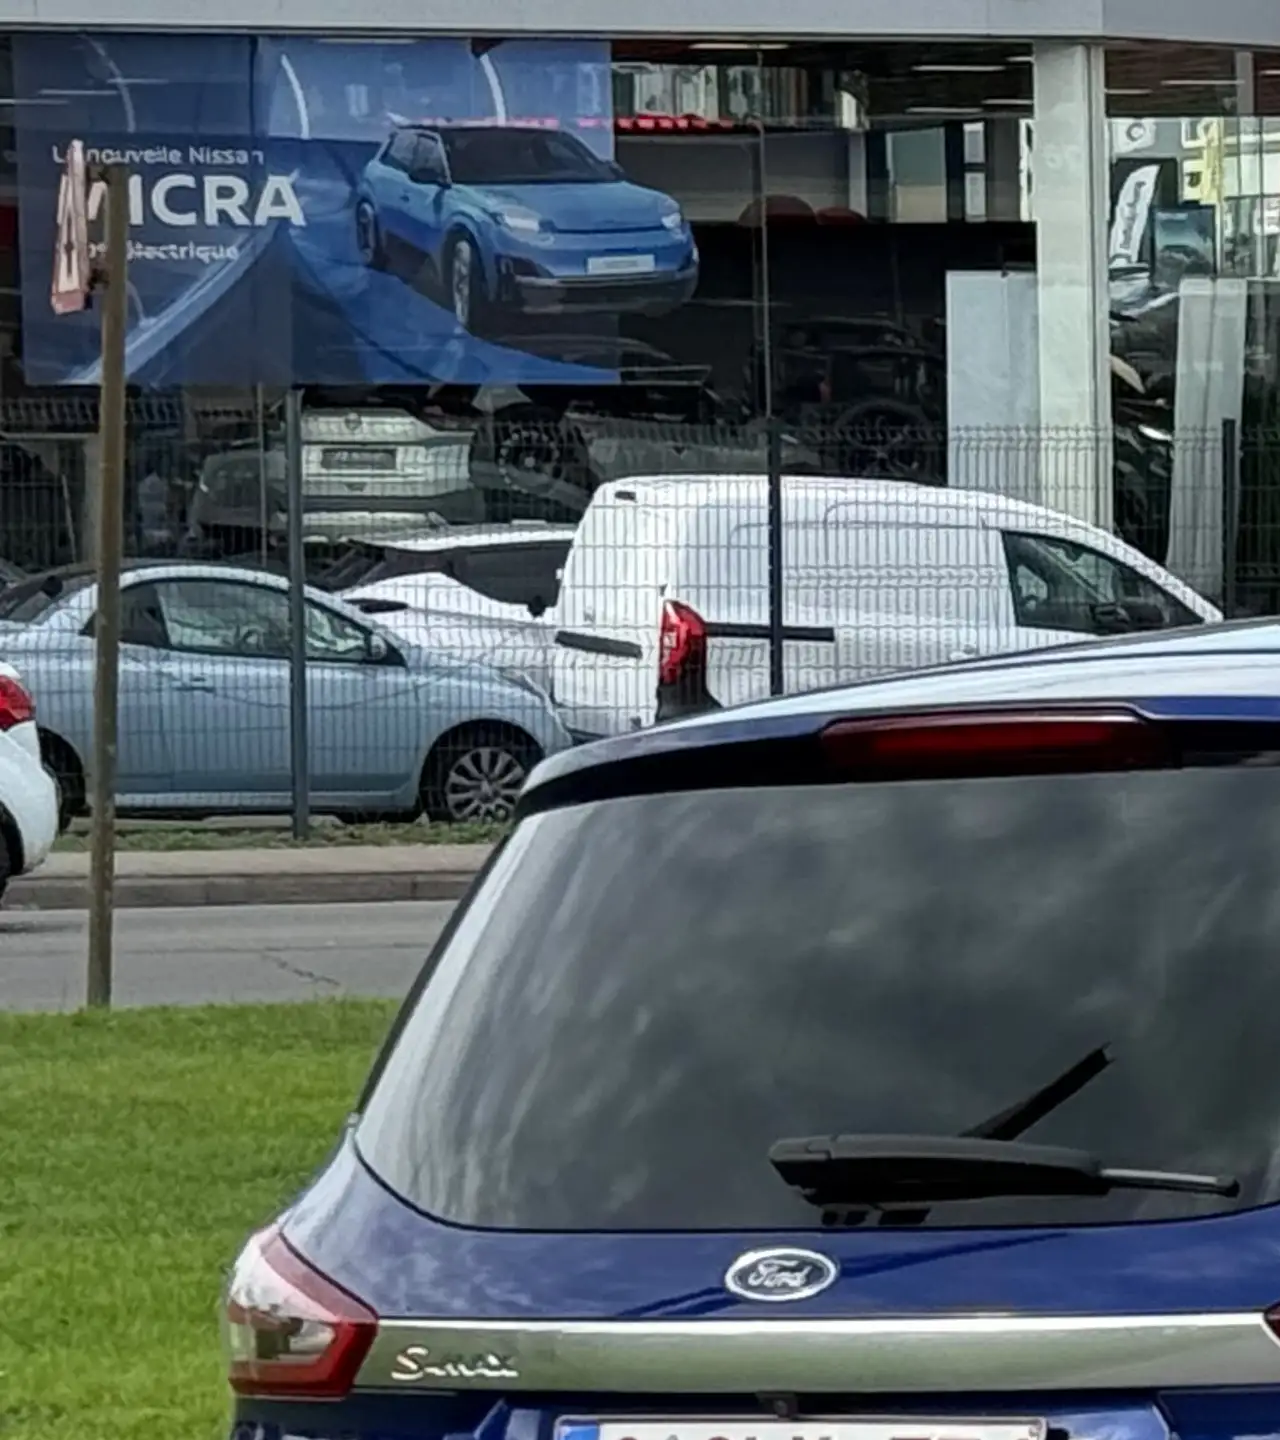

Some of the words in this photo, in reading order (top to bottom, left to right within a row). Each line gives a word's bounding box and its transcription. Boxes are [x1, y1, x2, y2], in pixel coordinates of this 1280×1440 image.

[86, 146, 182, 164] nouvelle
[189, 147, 264, 164] Nissan
[748, 1259, 813, 1288] Ford
